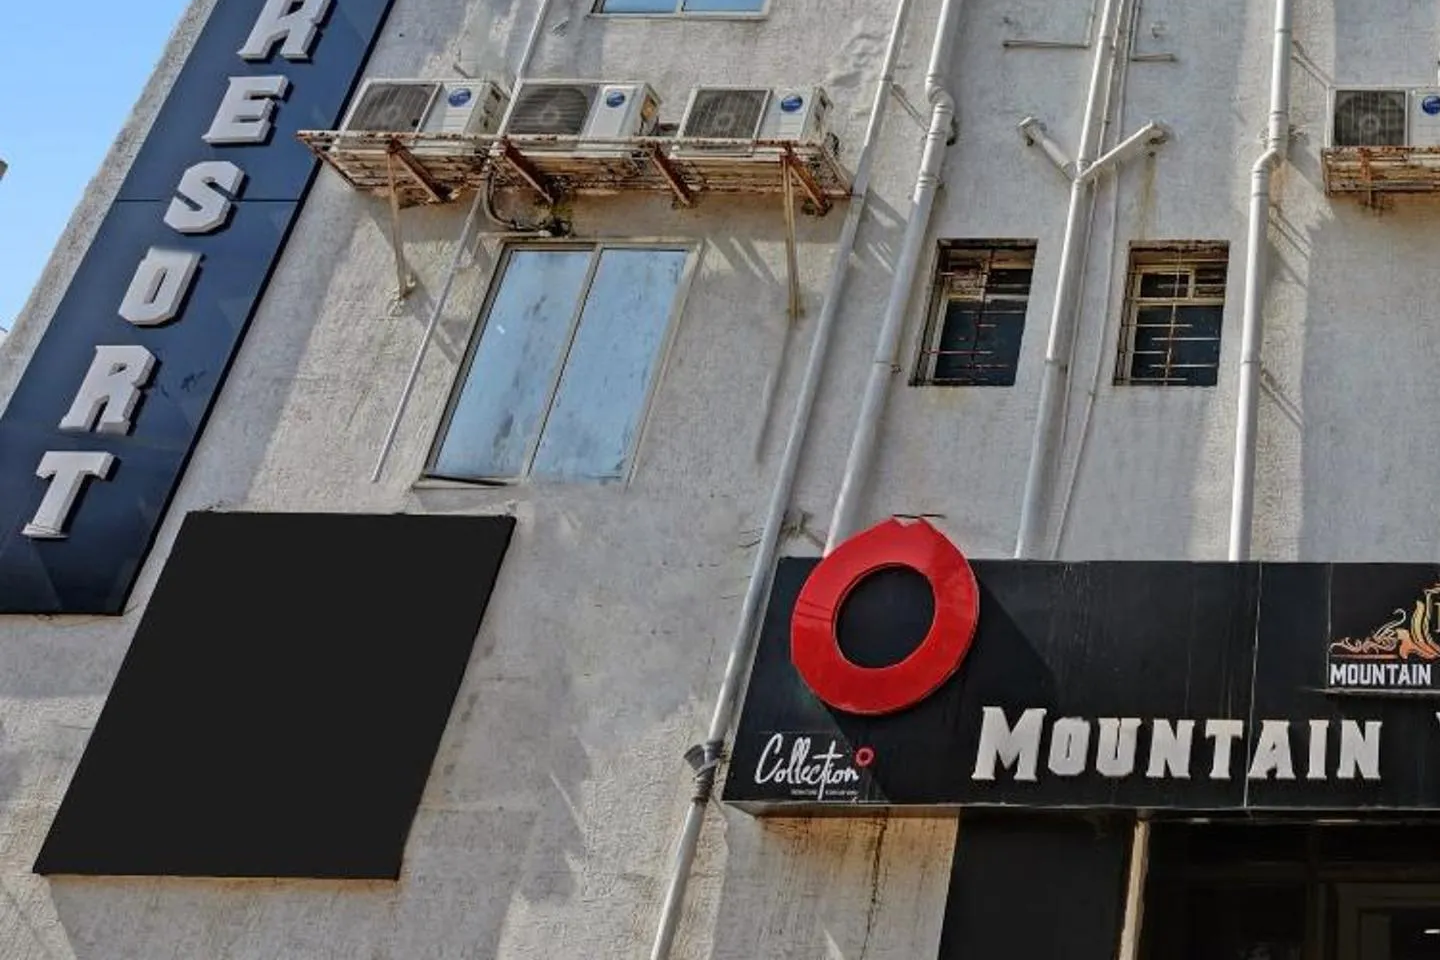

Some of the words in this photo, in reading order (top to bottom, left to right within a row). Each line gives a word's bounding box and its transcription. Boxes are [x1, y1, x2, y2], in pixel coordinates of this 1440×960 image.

[1330, 663, 1431, 686] MOUNTAIN
[754, 733, 859, 800] Collection
[972, 706, 1382, 781] MOUNTAIN
